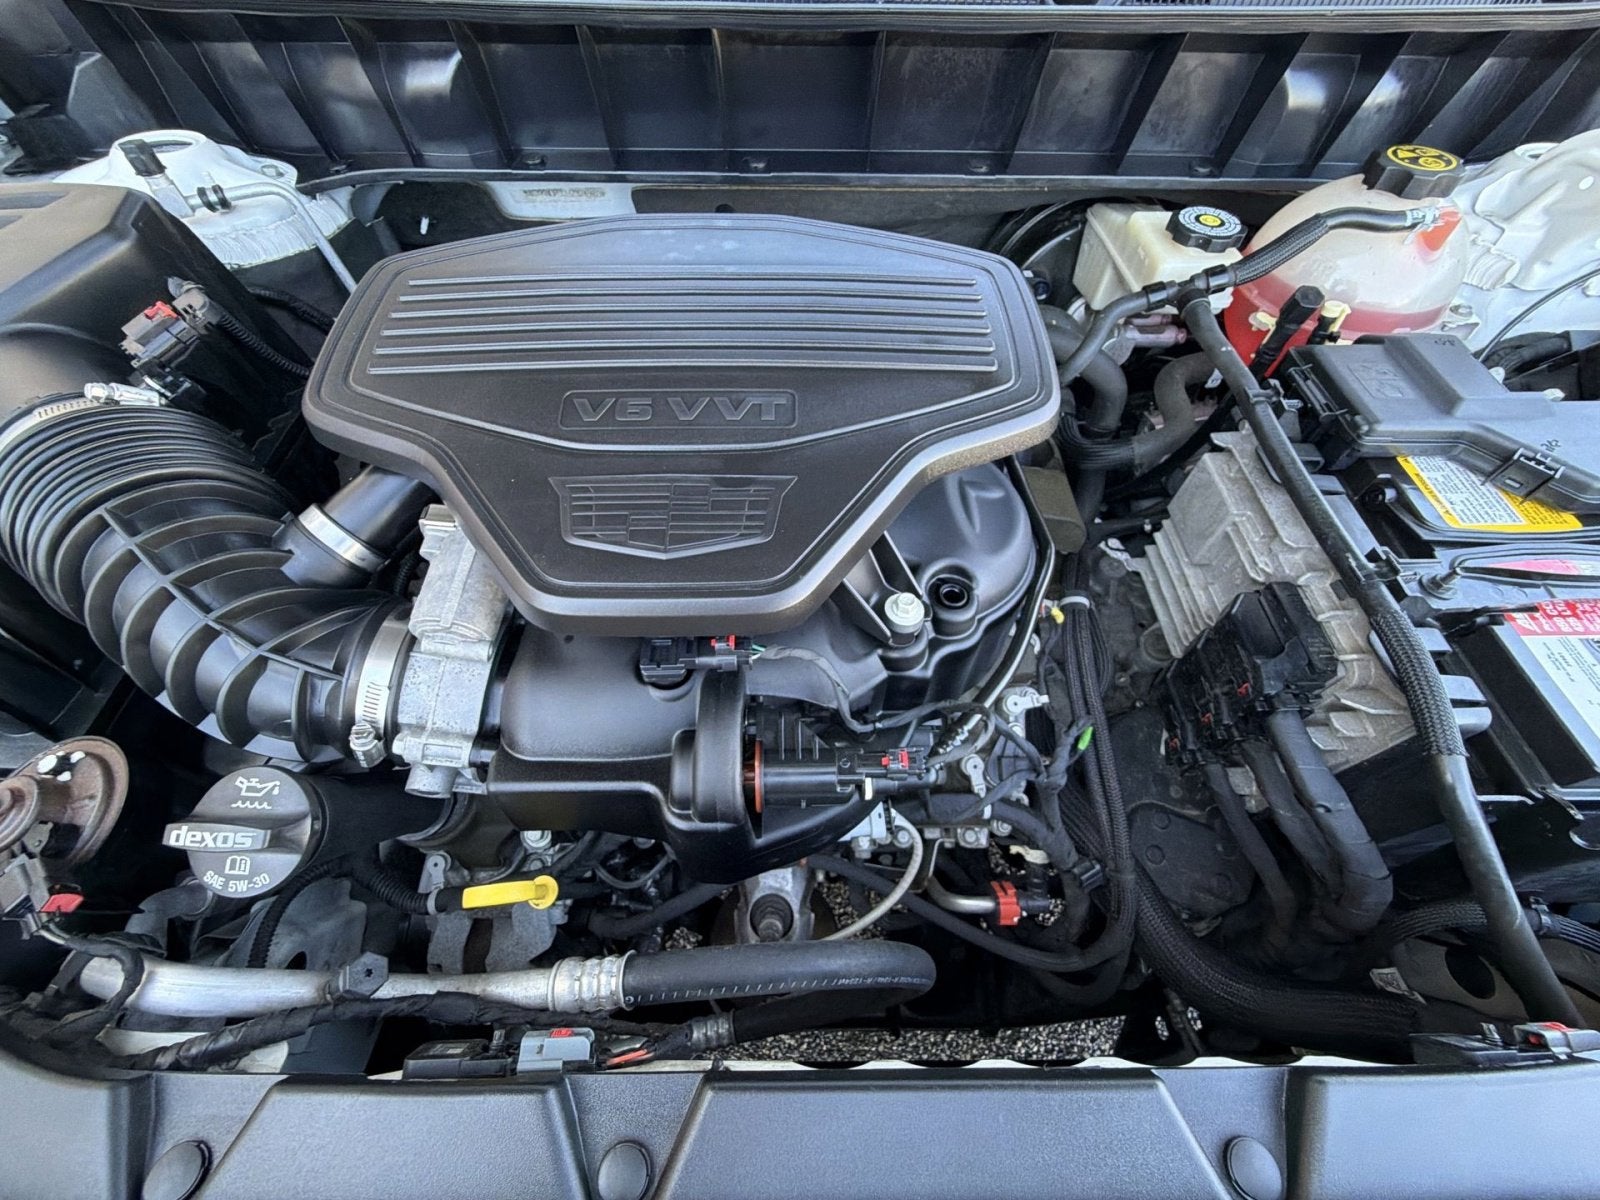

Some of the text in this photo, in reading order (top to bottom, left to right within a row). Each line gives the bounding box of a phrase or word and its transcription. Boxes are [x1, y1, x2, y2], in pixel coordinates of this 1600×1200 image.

[573, 397, 787, 421] V6 VVT
[169, 826, 256, 848] dexos
[203, 870, 270, 892] SAE 5W-30
